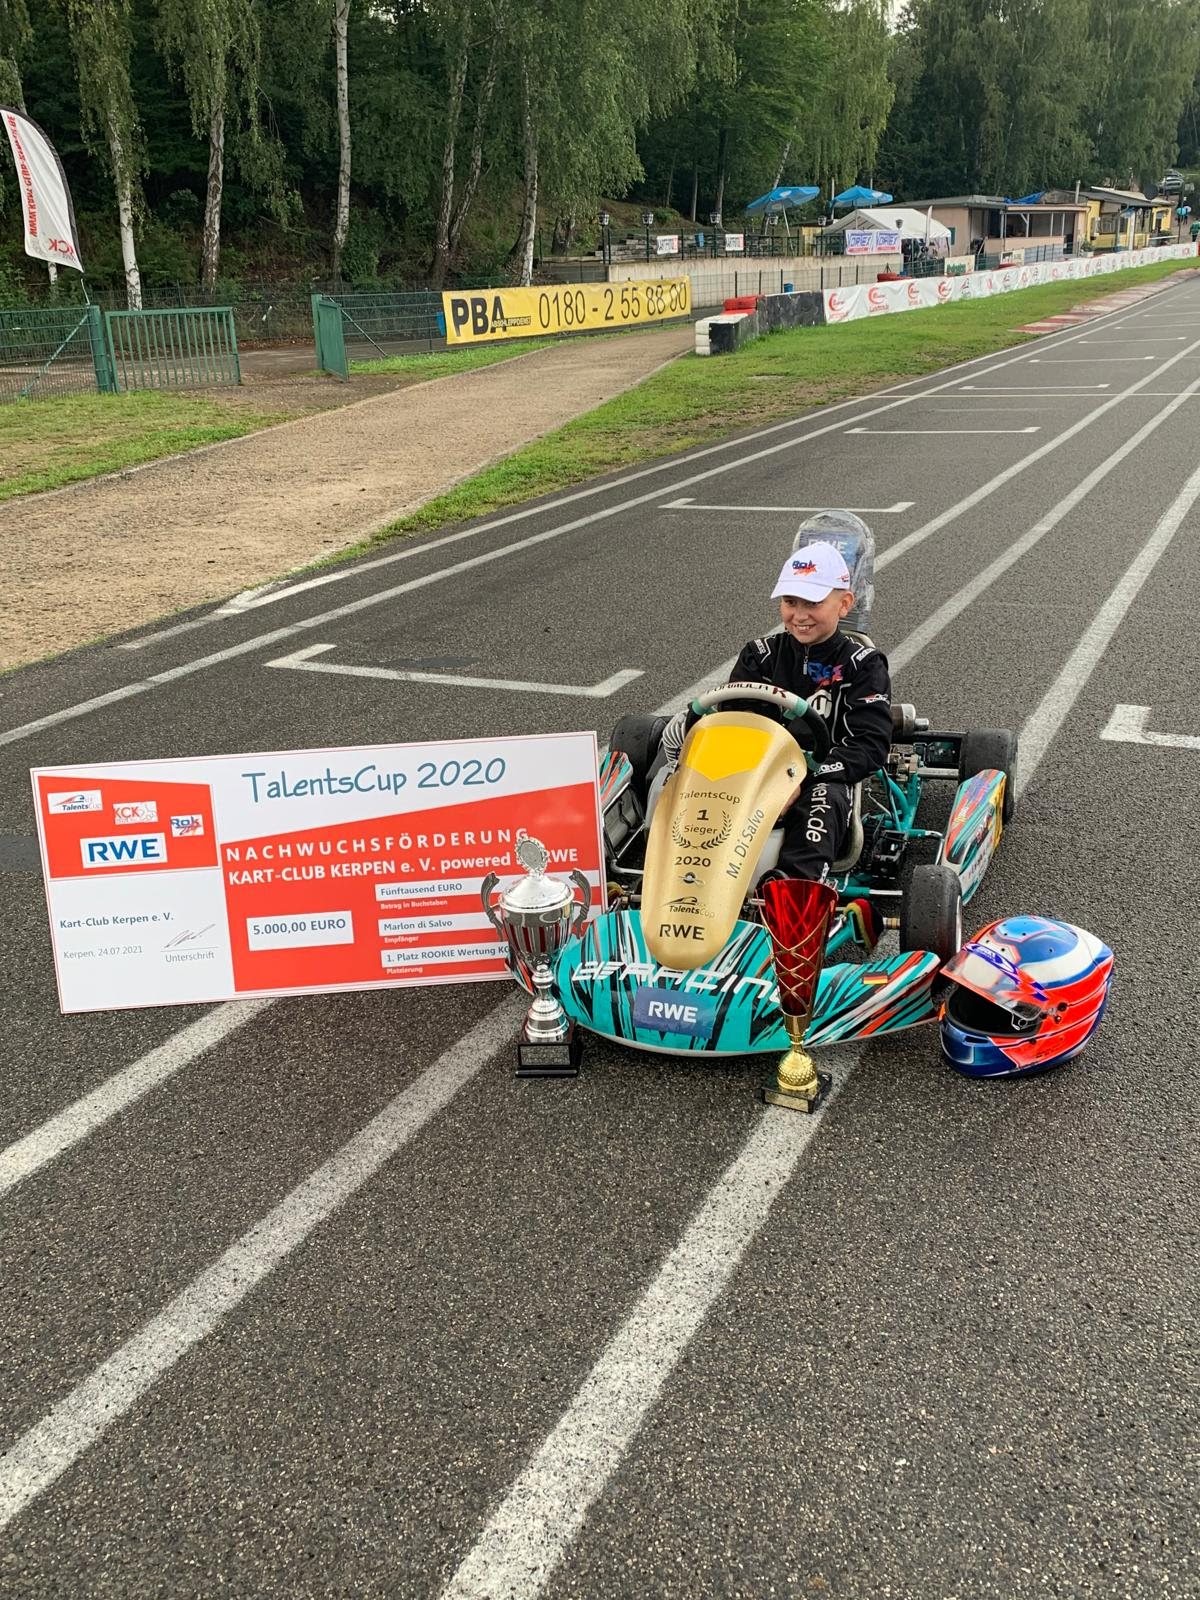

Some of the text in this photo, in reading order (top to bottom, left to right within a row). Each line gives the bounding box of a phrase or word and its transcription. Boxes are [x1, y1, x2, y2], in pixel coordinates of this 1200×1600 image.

[539, 290, 585, 328] 0180
[604, 288, 614, 320] 2
[621, 286, 640, 319] 55
[646, 284, 665, 316] 88
[451, 295, 507, 337] PBA
[241, 757, 506, 803] TalentsCup 2020
[680, 790, 741, 805] TalentsCup
[697, 809, 709, 821] 1
[684, 825, 718, 835] Sieger
[88, 838, 160, 863] RWE
[726, 809, 765, 879] M. Di Salvo
[229, 865, 325, 886] KART-CLUB
[331, 860, 395, 878] KERPEN
[401, 862, 415, 873] e.
[419, 858, 435, 872] V.
[441, 852, 510, 874] powered
[675, 856, 711, 868] 2020
[380, 883, 463, 897] Fünftausend EURO
[380, 901, 401, 910] Betrag
[411, 899, 448, 908] Buchstaben
[669, 905, 715, 919] TalentsCup
[60, 912, 174, 929] Kart-Club Kerpen e. V.
[253, 918, 346, 935] 5.000,00 EURO
[383, 919, 453, 931] Marlon di Salvo
[659, 924, 705, 940] RWE
[63, 945, 143, 961] Kerpen, 24.07.2021
[165, 950, 215, 963] Unterschrift
[386, 954, 395, 963] 1.
[397, 952, 419, 962] Platz
[421, 949, 455, 959] ROOKIE
[457, 946, 496, 957] Wertung
[648, 1001, 698, 1023] RWE
